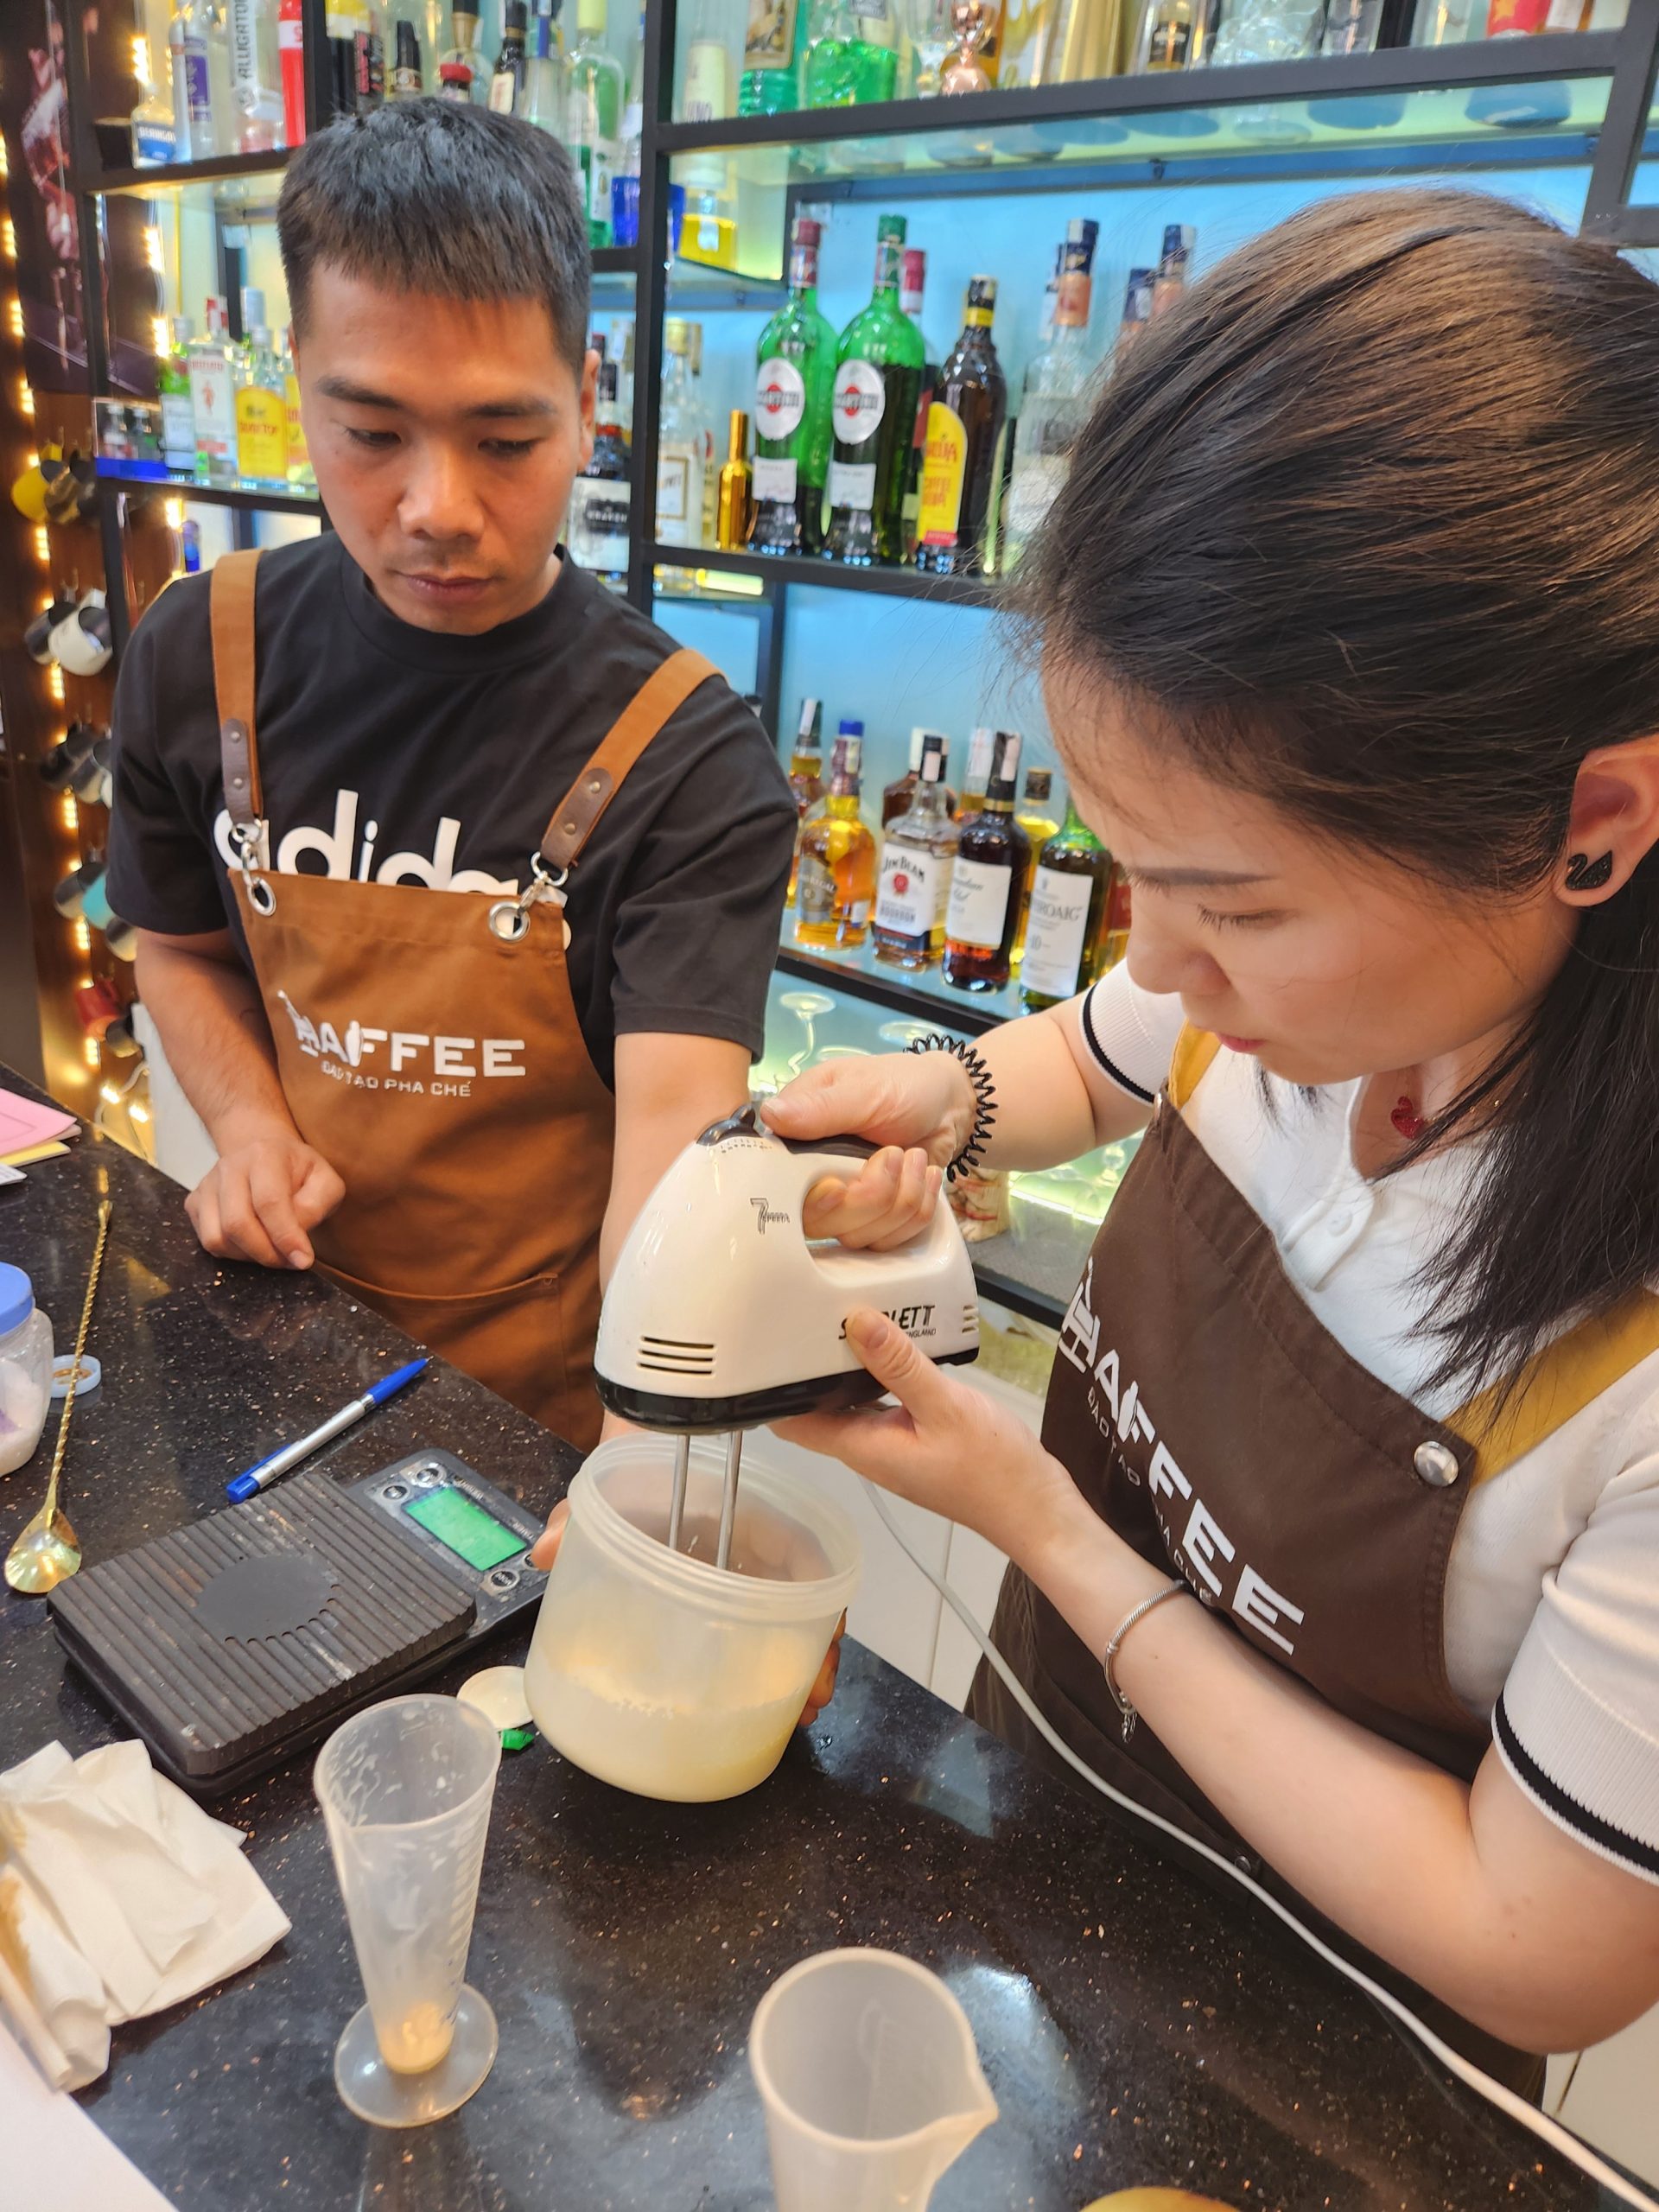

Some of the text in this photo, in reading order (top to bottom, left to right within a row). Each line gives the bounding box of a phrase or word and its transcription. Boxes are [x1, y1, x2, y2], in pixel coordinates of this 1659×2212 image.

[235, 0, 251, 79] ALLIGATO
[385, 1078, 424, 1094] PHA
[750, 1198, 769, 1235] 7
